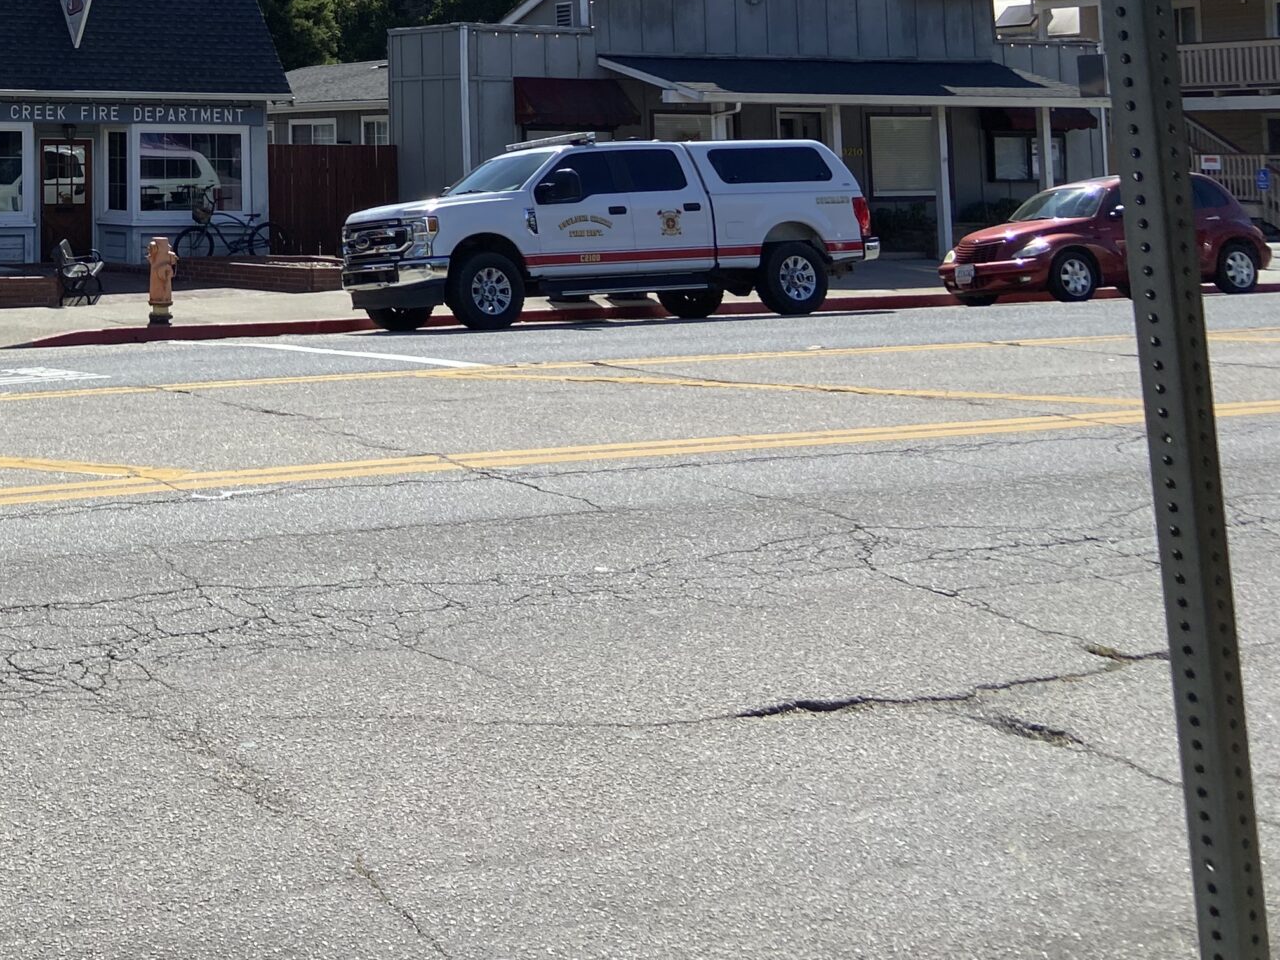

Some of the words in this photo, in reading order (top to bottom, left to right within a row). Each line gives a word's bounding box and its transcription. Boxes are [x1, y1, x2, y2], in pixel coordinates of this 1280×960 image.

[10, 105, 66, 121] CREEK
[80, 106, 119, 121] FIRE
[133, 107, 244, 123] DEPARTMENT
